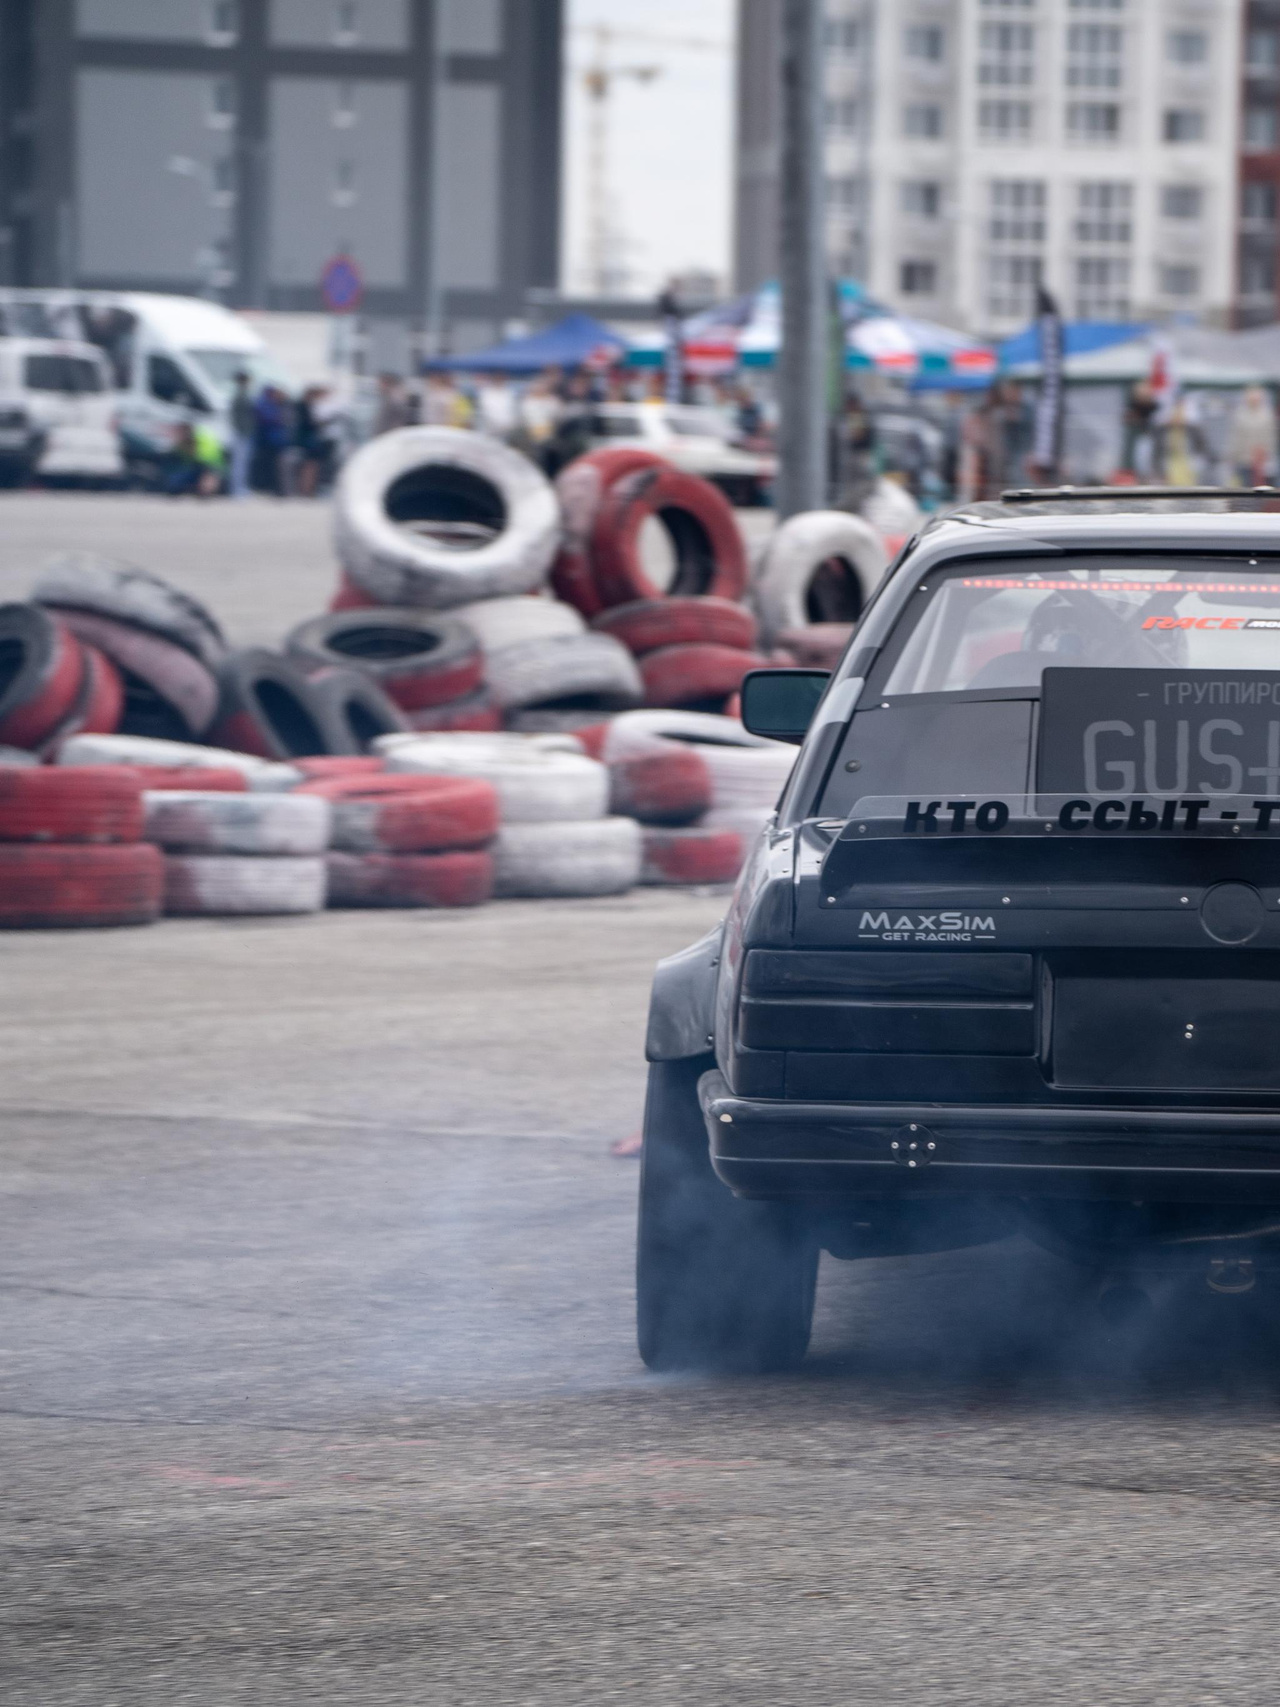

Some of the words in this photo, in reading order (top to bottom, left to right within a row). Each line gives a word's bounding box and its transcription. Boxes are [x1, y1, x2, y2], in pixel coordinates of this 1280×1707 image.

[1141, 616, 1246, 630] RACE
[903, 801, 1009, 832] КТО
[882, 932, 911, 941] GET
[915, 932, 972, 941] RACING
